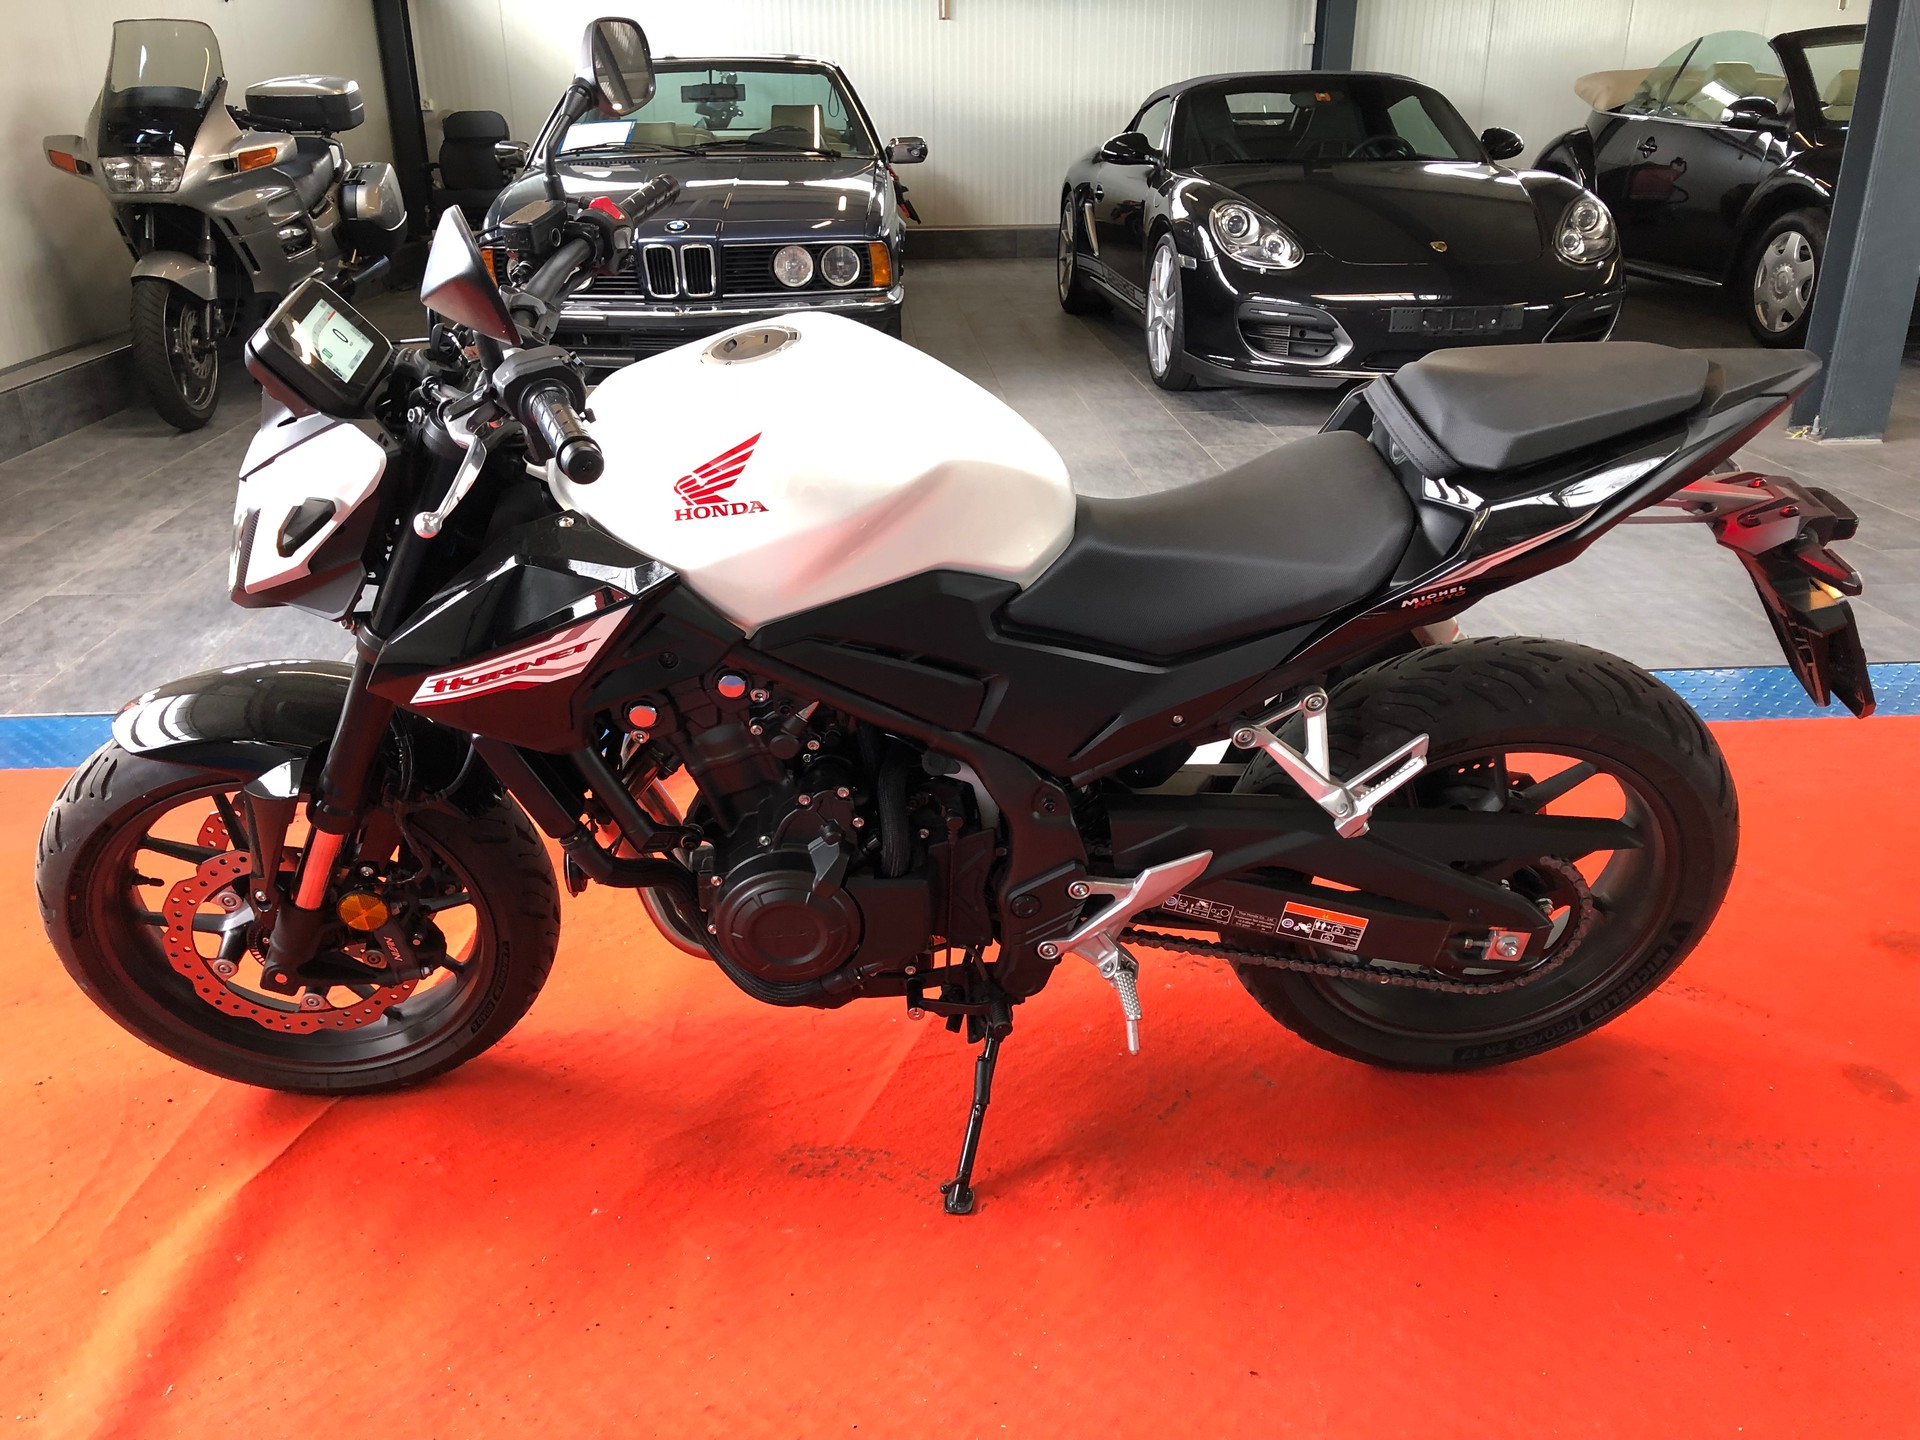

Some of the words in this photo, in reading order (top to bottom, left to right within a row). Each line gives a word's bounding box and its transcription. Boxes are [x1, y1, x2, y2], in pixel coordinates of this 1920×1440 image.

[332, 328, 348, 343] 0
[674, 501, 769, 521] HONDA
[1401, 586, 1466, 608] MICHEL
[1413, 591, 1466, 608] MOTO
[1588, 945, 1671, 1020] MICHELIN
